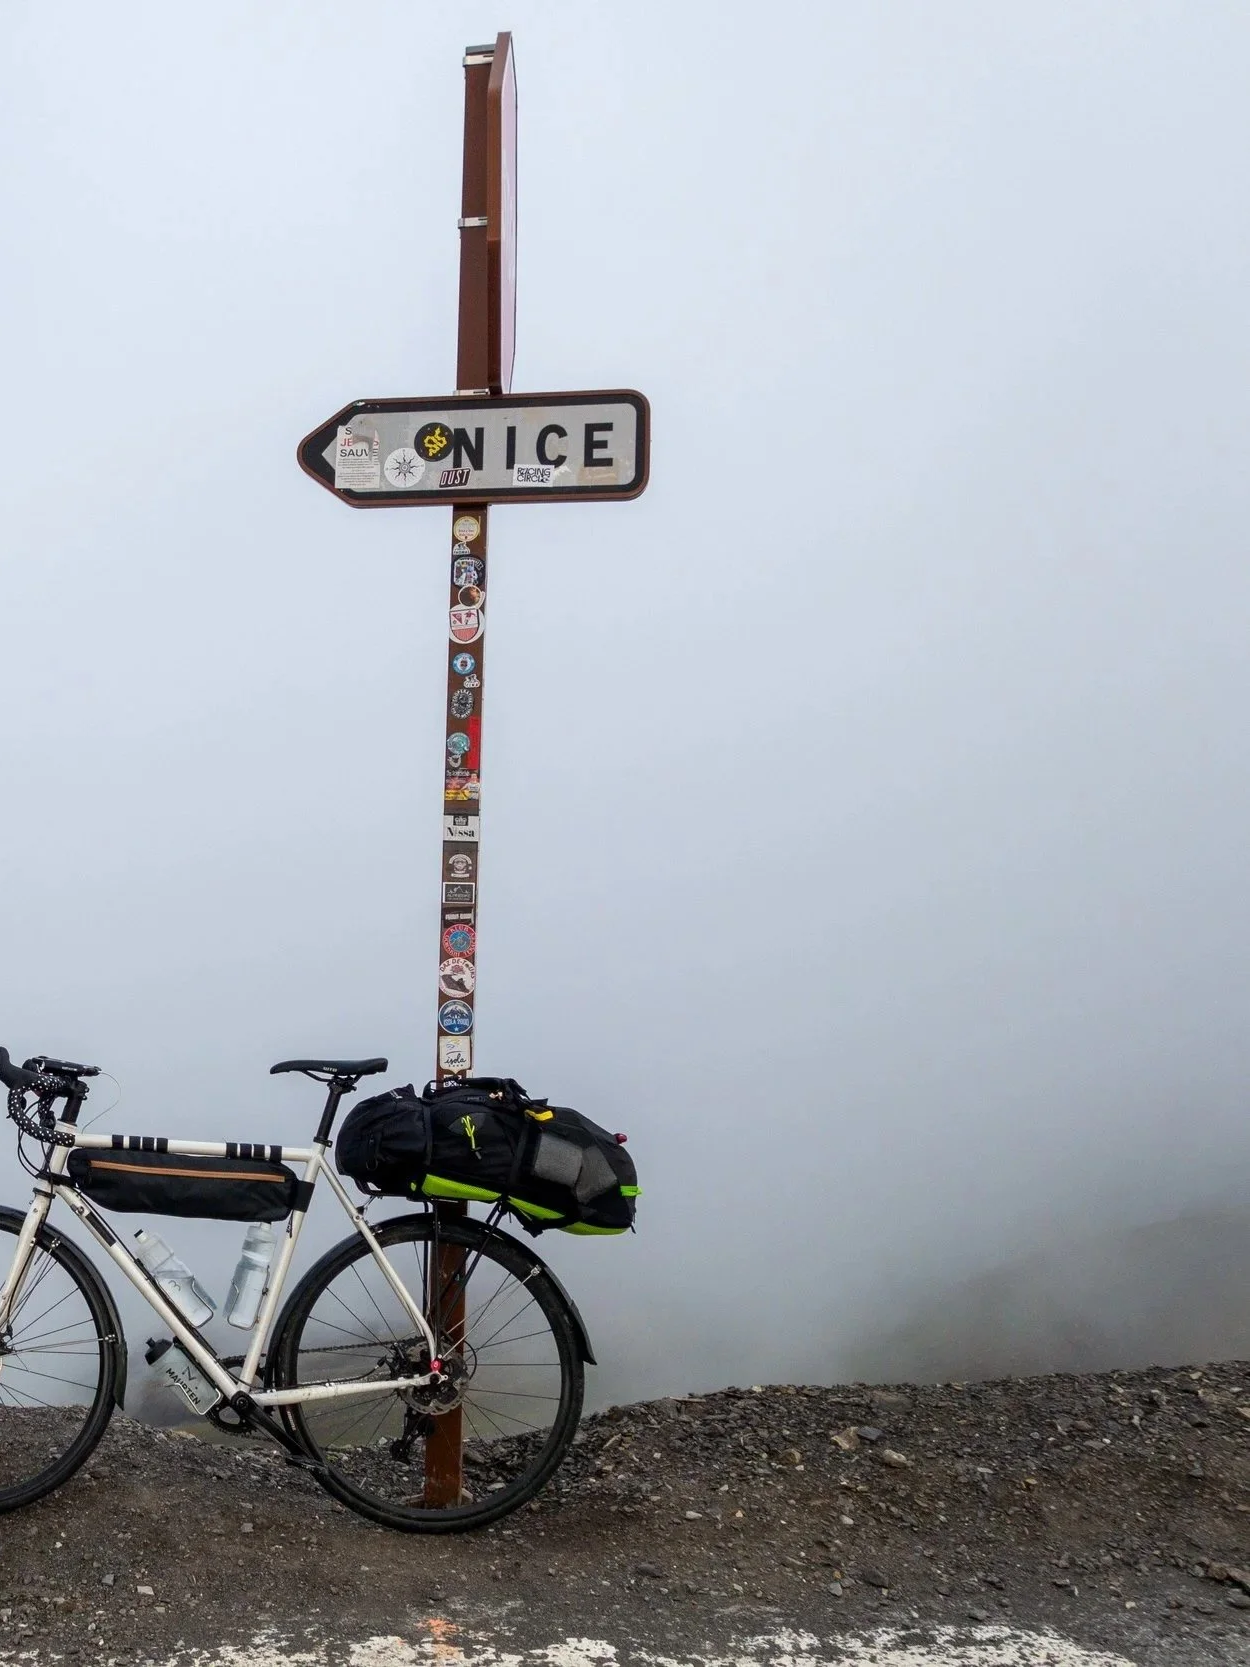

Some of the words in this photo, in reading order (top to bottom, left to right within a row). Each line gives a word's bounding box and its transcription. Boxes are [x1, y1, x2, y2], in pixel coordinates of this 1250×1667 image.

[453, 422, 613, 470] NICE
[440, 469, 470, 485] DUST
[517, 467, 551, 477] RACING
